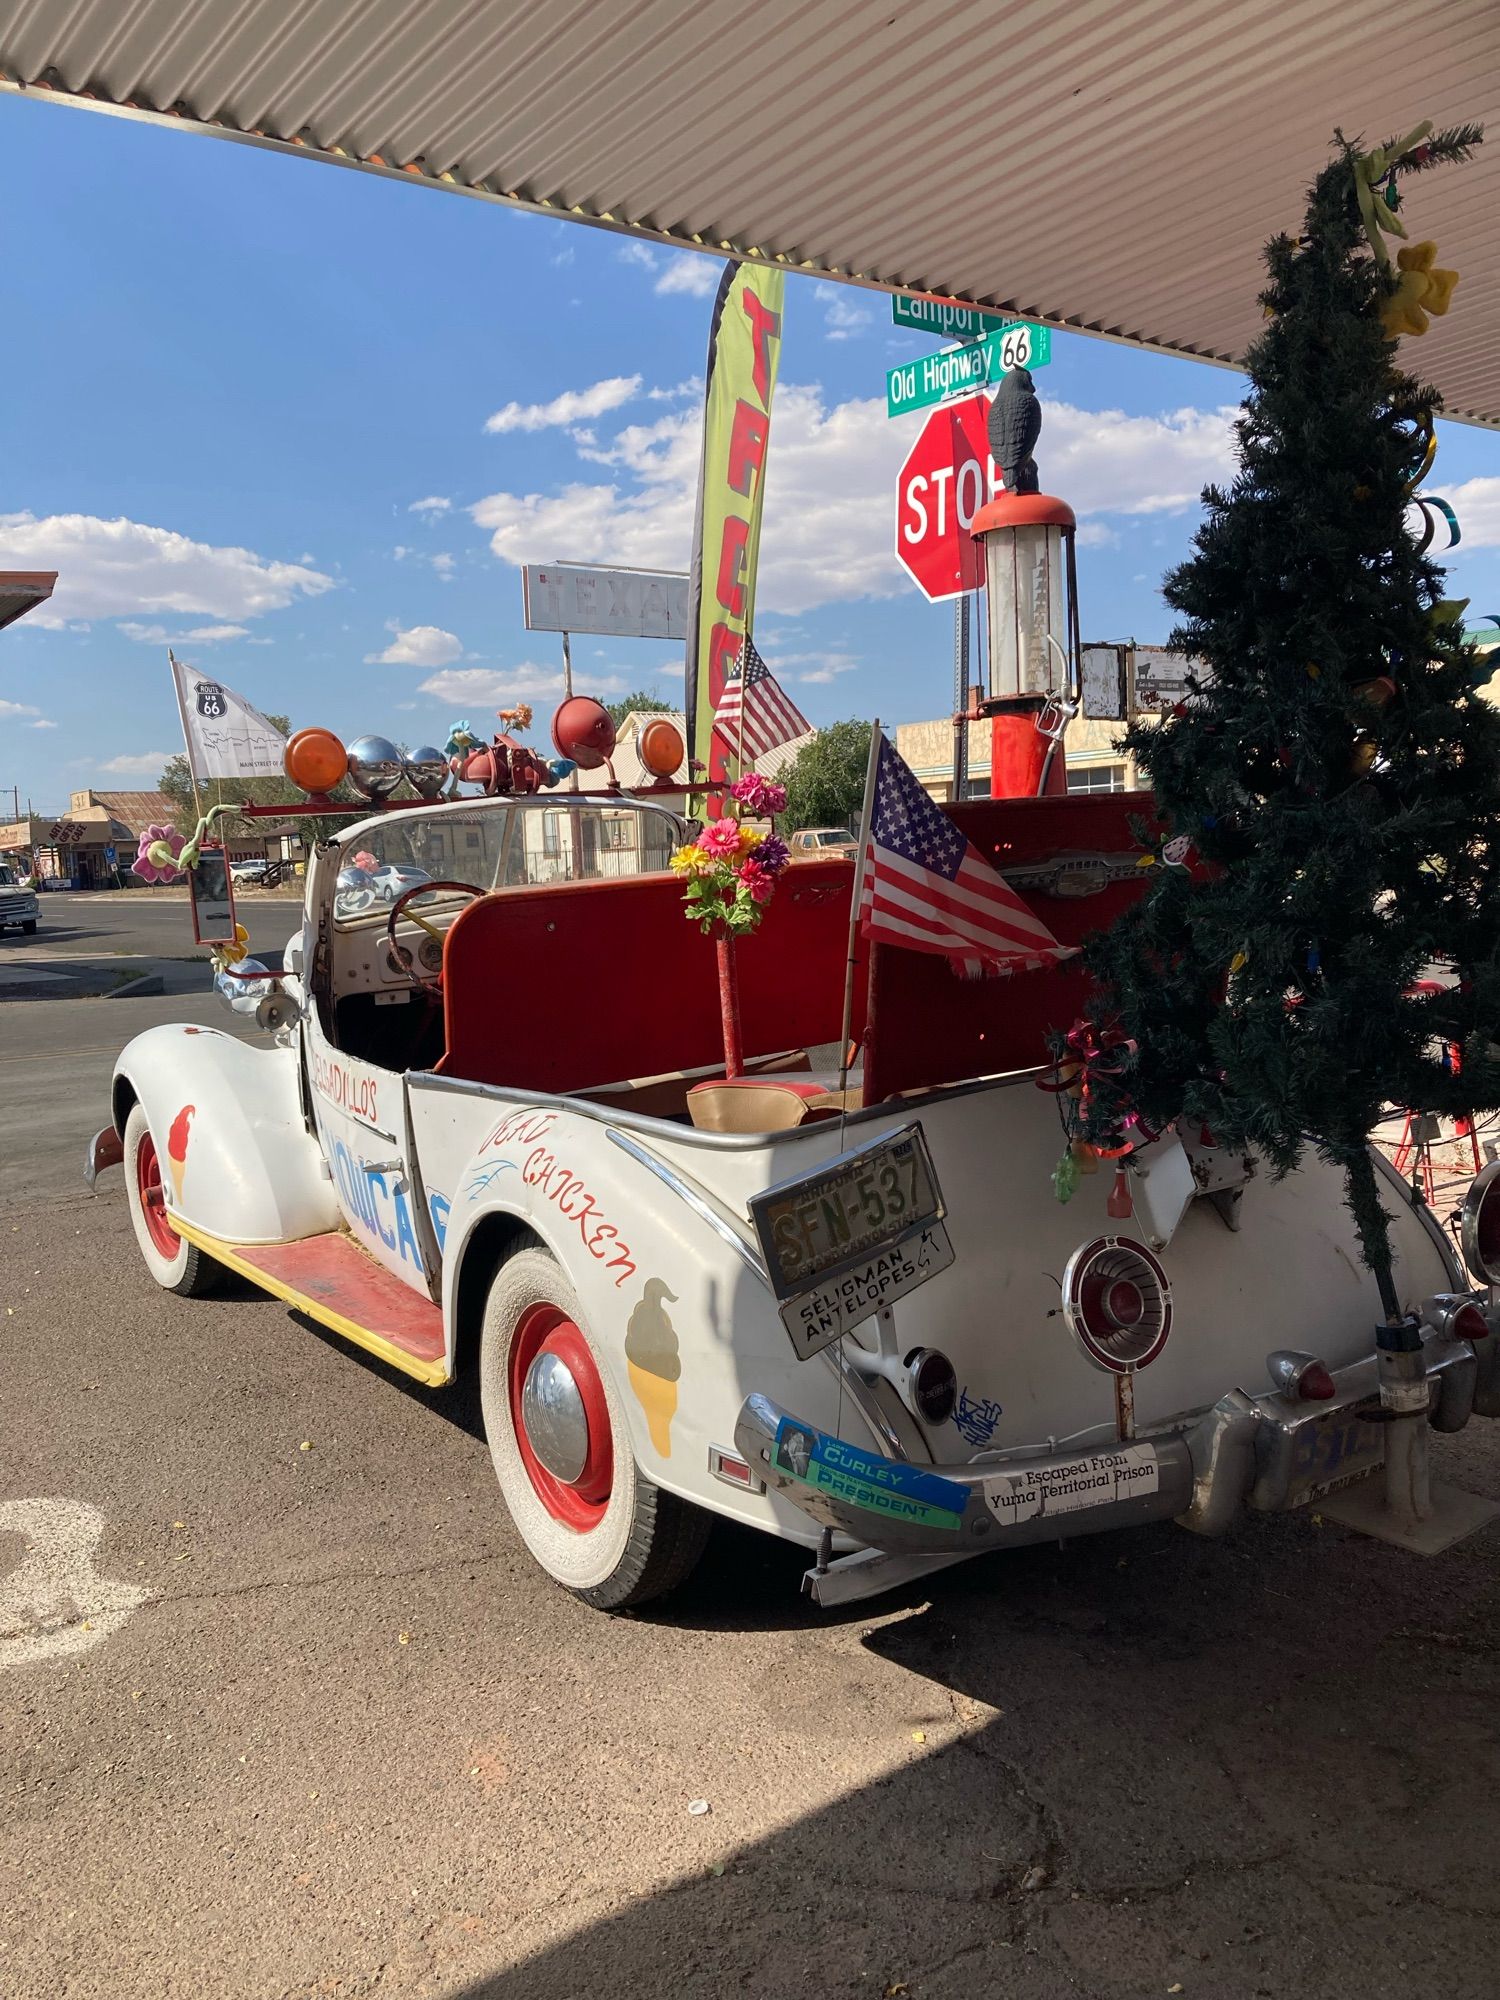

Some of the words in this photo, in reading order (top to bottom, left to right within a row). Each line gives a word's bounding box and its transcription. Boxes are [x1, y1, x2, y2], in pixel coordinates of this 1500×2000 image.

[891, 366, 915, 404] Old
[923, 344, 993, 395] Highway
[1003, 332, 1027, 367] 66
[538, 573, 689, 620] TEXA
[200, 685, 219, 694] ROUTE
[203, 702, 220, 715] 66
[48, 823, 63, 840] ART
[59, 822, 76, 842] GIFTS
[71, 823, 88, 842] CAFE
[773, 1157, 919, 1267] SFN-537
[800, 1249, 904, 1324] SELIGMAN
[806, 1260, 916, 1342] ANTELOPES
[823, 1446, 904, 1486] CURLEY
[991, 1491, 1036, 1509] Yuma
[1041, 1472, 1110, 1499] Territorial
[1113, 1464, 1154, 1483] Prison
[1026, 1461, 1088, 1486] Escaped
[1091, 1455, 1128, 1473] From
[817, 1469, 930, 1518] PRESIDENT
